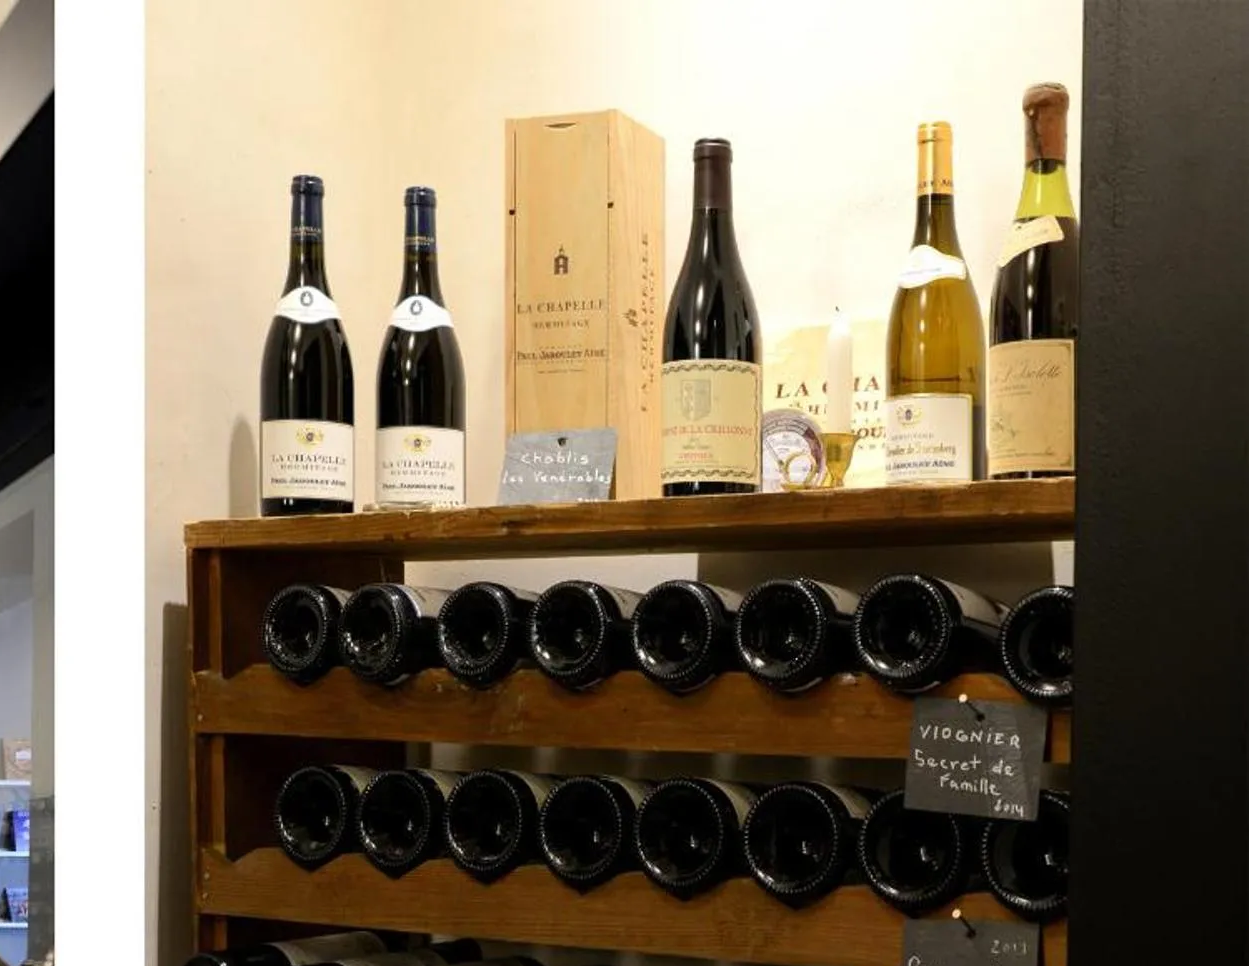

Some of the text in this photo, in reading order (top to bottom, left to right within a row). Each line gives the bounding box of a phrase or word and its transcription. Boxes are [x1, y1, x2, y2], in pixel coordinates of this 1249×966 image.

[517, 300, 603, 315] LA CHAPELLE
[271, 454, 347, 465] LA CHAPELLE
[521, 449, 589, 465] Chablis
[919, 724, 1021, 749] VIOGNIER
[914, 748, 1015, 777] Secret de
[939, 773, 1001, 796] Famille
[993, 799, 1025, 818] 2014
